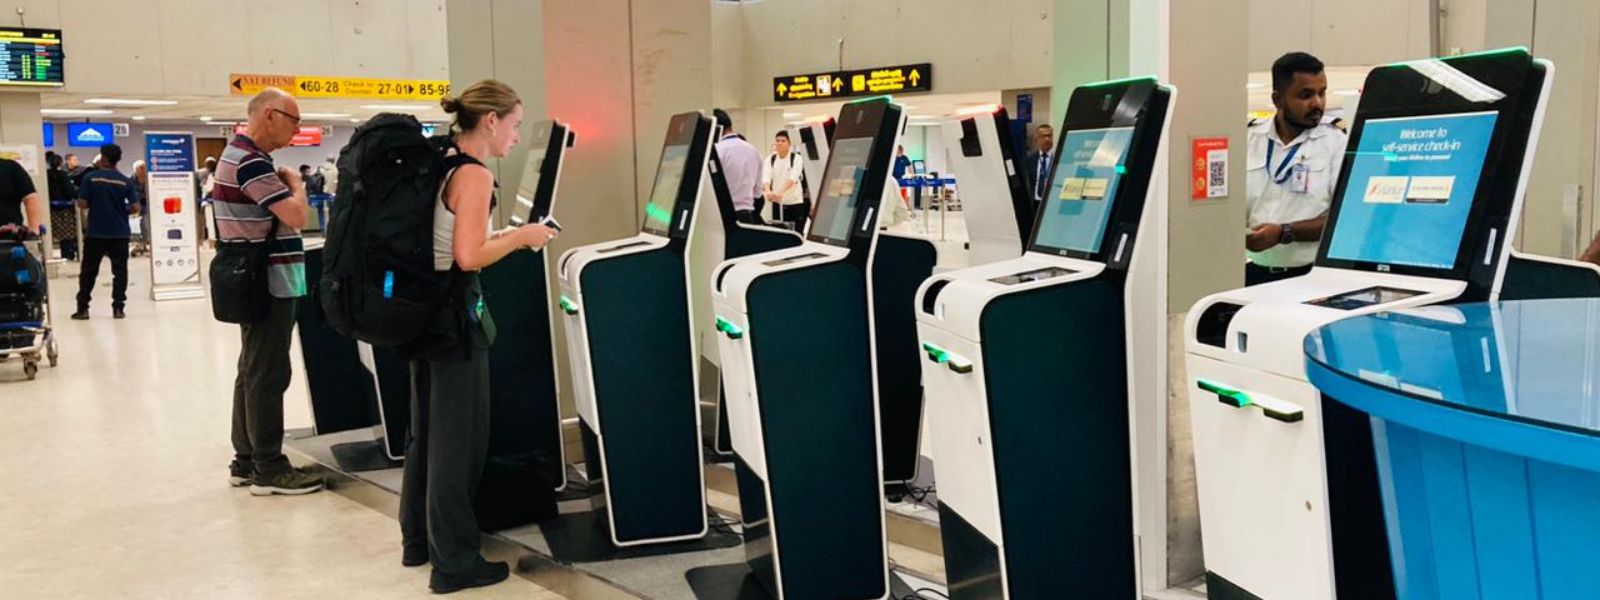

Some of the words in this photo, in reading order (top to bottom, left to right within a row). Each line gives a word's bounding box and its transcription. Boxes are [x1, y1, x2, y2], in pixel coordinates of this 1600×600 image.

[307, 81, 339, 92] 60-28
[378, 83, 409, 95] 27-01
[1400, 128, 1436, 140] Welcome
[1437, 127, 1448, 138] to
[1382, 141, 1424, 152] self-service
[1424, 138, 1461, 151] check-in
